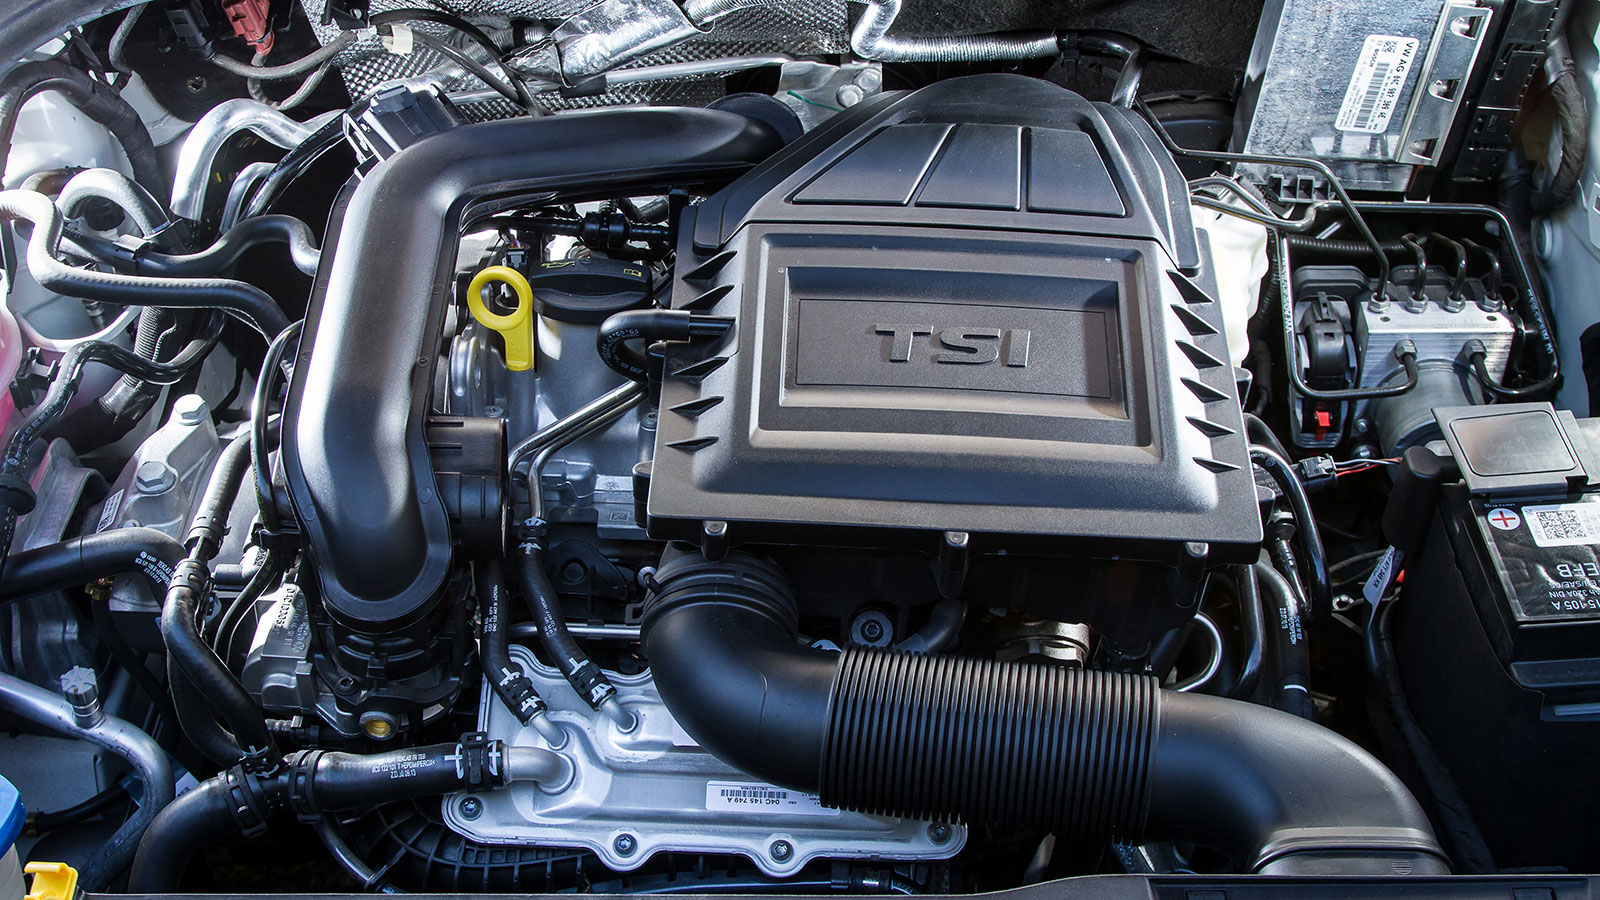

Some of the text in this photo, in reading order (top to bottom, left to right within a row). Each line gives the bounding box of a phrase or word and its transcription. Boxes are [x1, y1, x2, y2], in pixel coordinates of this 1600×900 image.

[1402, 41, 1415, 57] VW
[1396, 59, 1407, 73] AG
[873, 323, 1031, 368] TSI
[1556, 562, 1600, 578] EFB
[1549, 591, 1566, 599] DIN
[1551, 601, 1561, 611] A
[1564, 600, 1586, 610] 105
